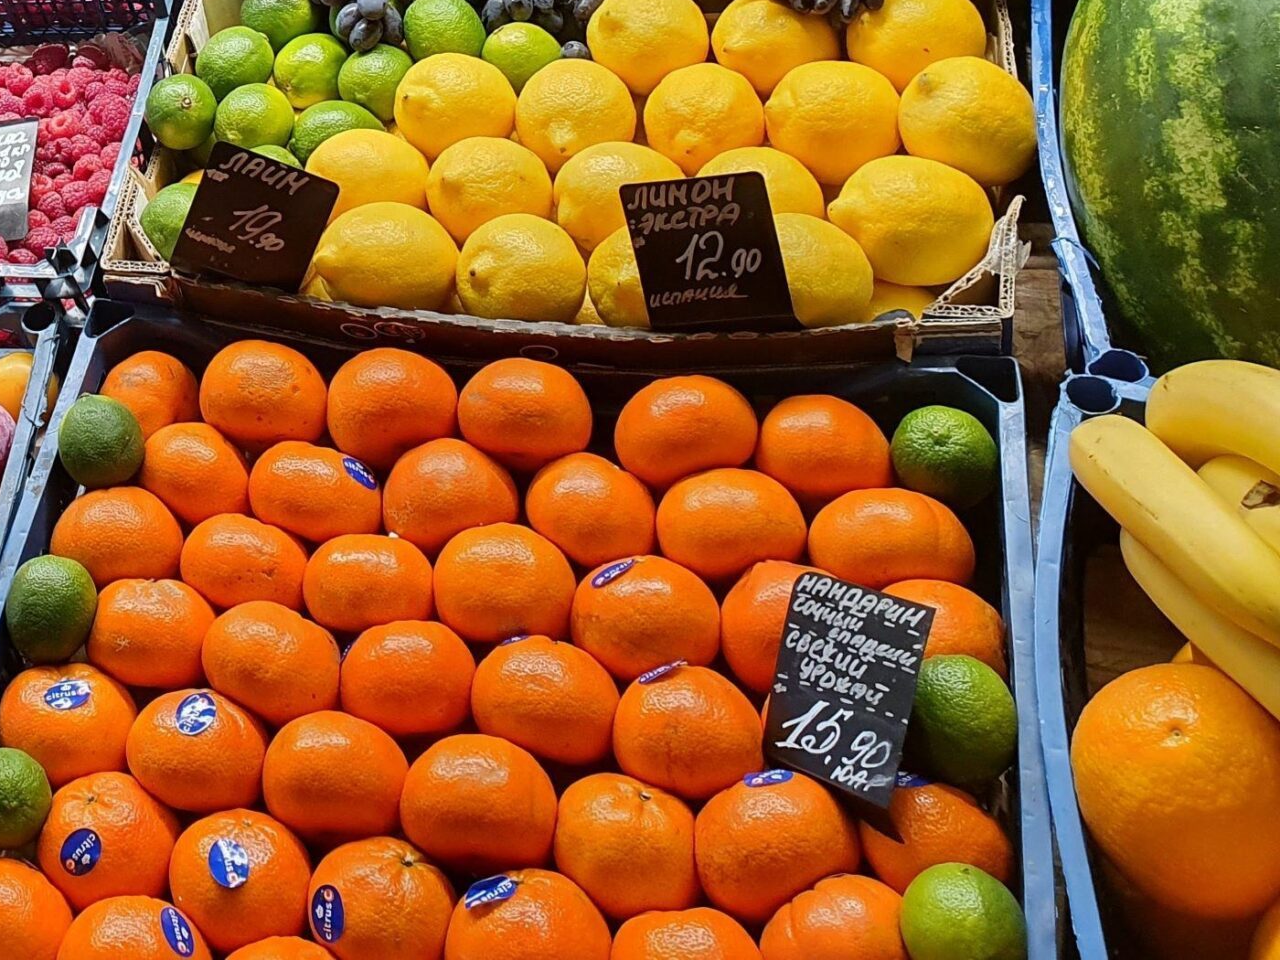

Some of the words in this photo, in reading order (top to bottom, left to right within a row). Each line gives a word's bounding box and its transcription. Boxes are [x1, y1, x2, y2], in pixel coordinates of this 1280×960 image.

[627, 177, 735, 210] ЛИМОН
[638, 203, 741, 235] ЭКСТРА
[46, 691, 76, 701] citrus
[72, 833, 96, 861] citrus
[169, 908, 183, 942] citrus
[325, 902, 333, 940] citrus
